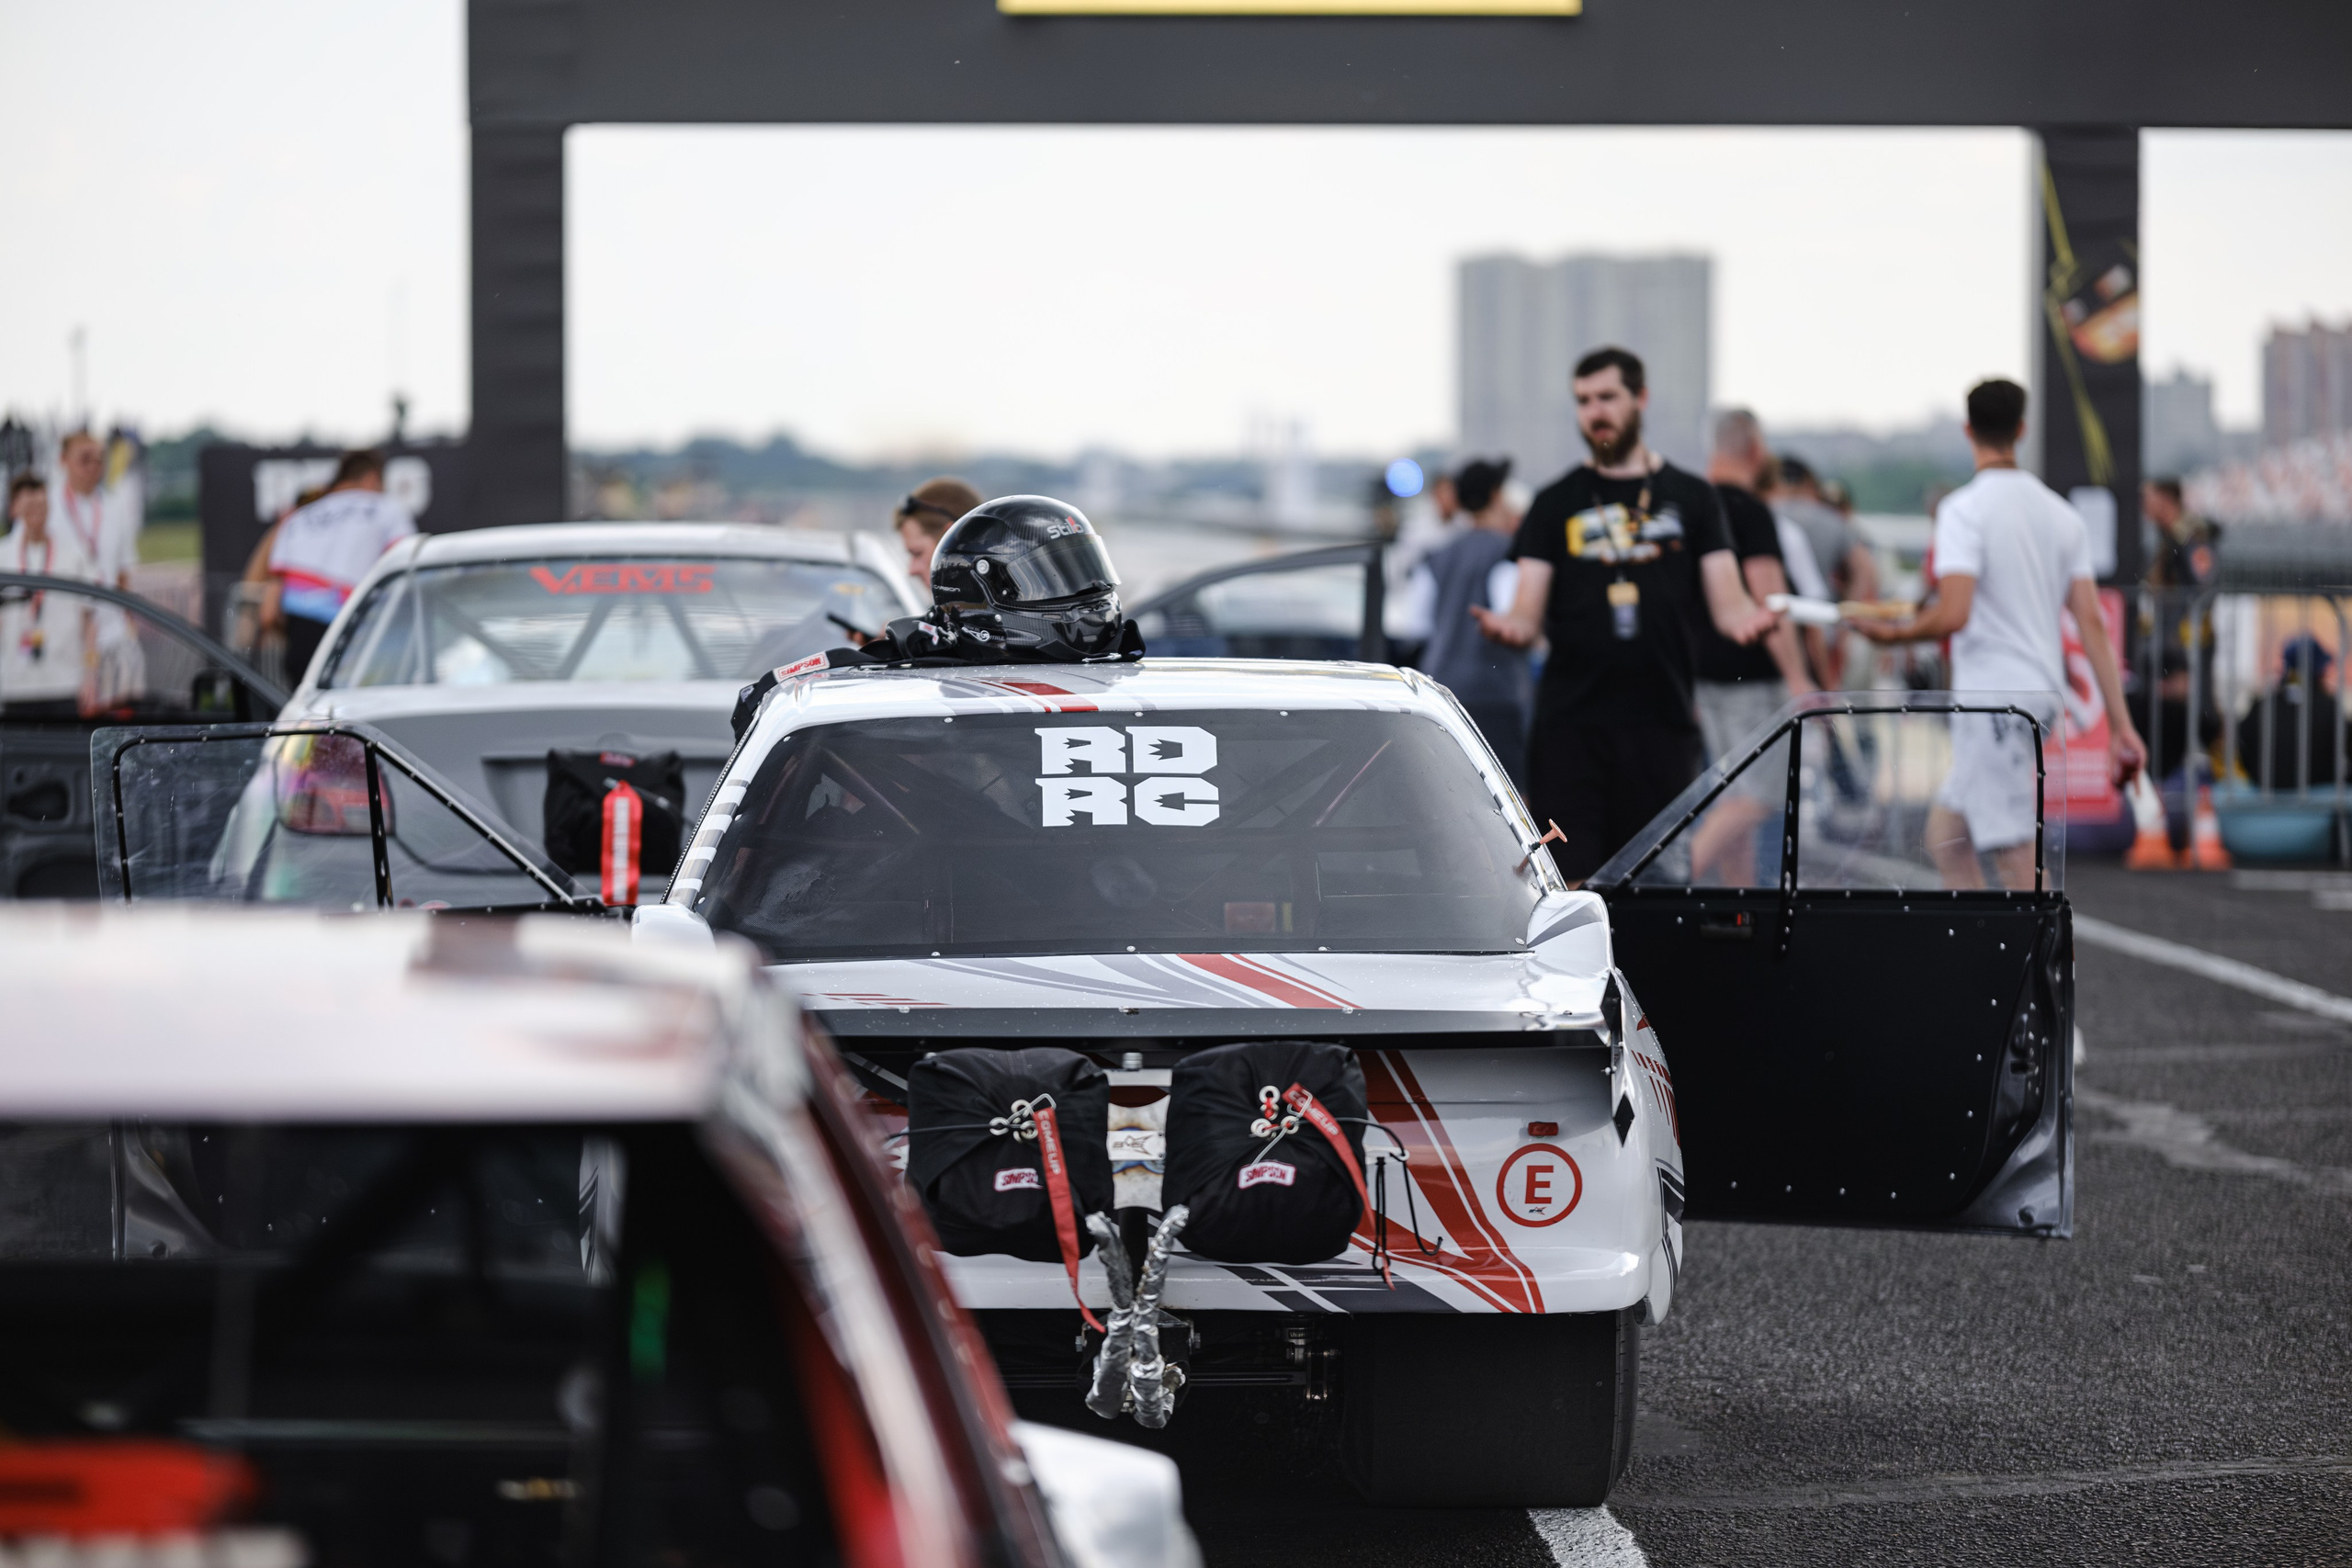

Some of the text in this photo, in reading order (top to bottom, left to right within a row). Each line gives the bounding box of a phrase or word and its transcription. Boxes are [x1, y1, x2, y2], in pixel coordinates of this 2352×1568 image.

[529, 563, 717, 594] VEMS
[781, 657, 821, 677] SIMPSON
[1035, 726, 1218, 774] RD
[1035, 776, 1220, 827] RC
[1524, 1165, 1555, 1204] E
